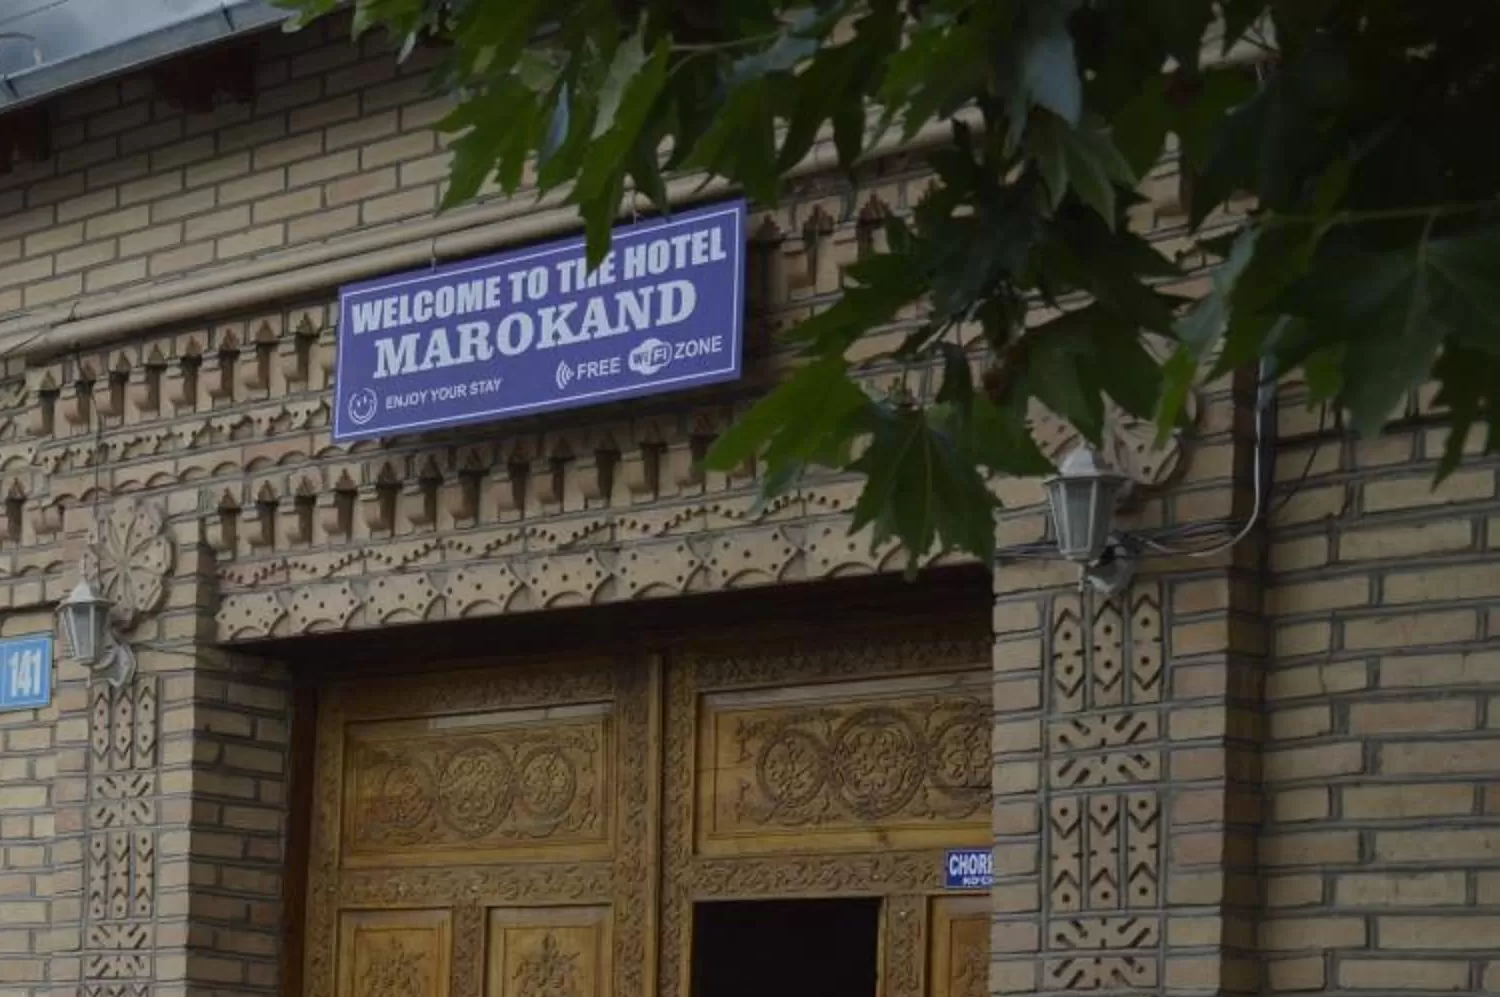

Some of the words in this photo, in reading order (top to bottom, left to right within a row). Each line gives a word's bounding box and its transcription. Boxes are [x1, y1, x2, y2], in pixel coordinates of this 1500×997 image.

[351, 276, 502, 335] WELCOME
[507, 265, 549, 304] TO
[556, 250, 617, 294] THE
[623, 226, 728, 281] HOTEL
[372, 278, 698, 379] MAROKAND
[576, 356, 622, 381] FREE
[673, 335, 723, 360] ZONE
[385, 389, 429, 411] ENJOY
[430, 383, 468, 402] YOUR
[469, 377, 503, 396] STAY
[8, 648, 42, 698] 141
